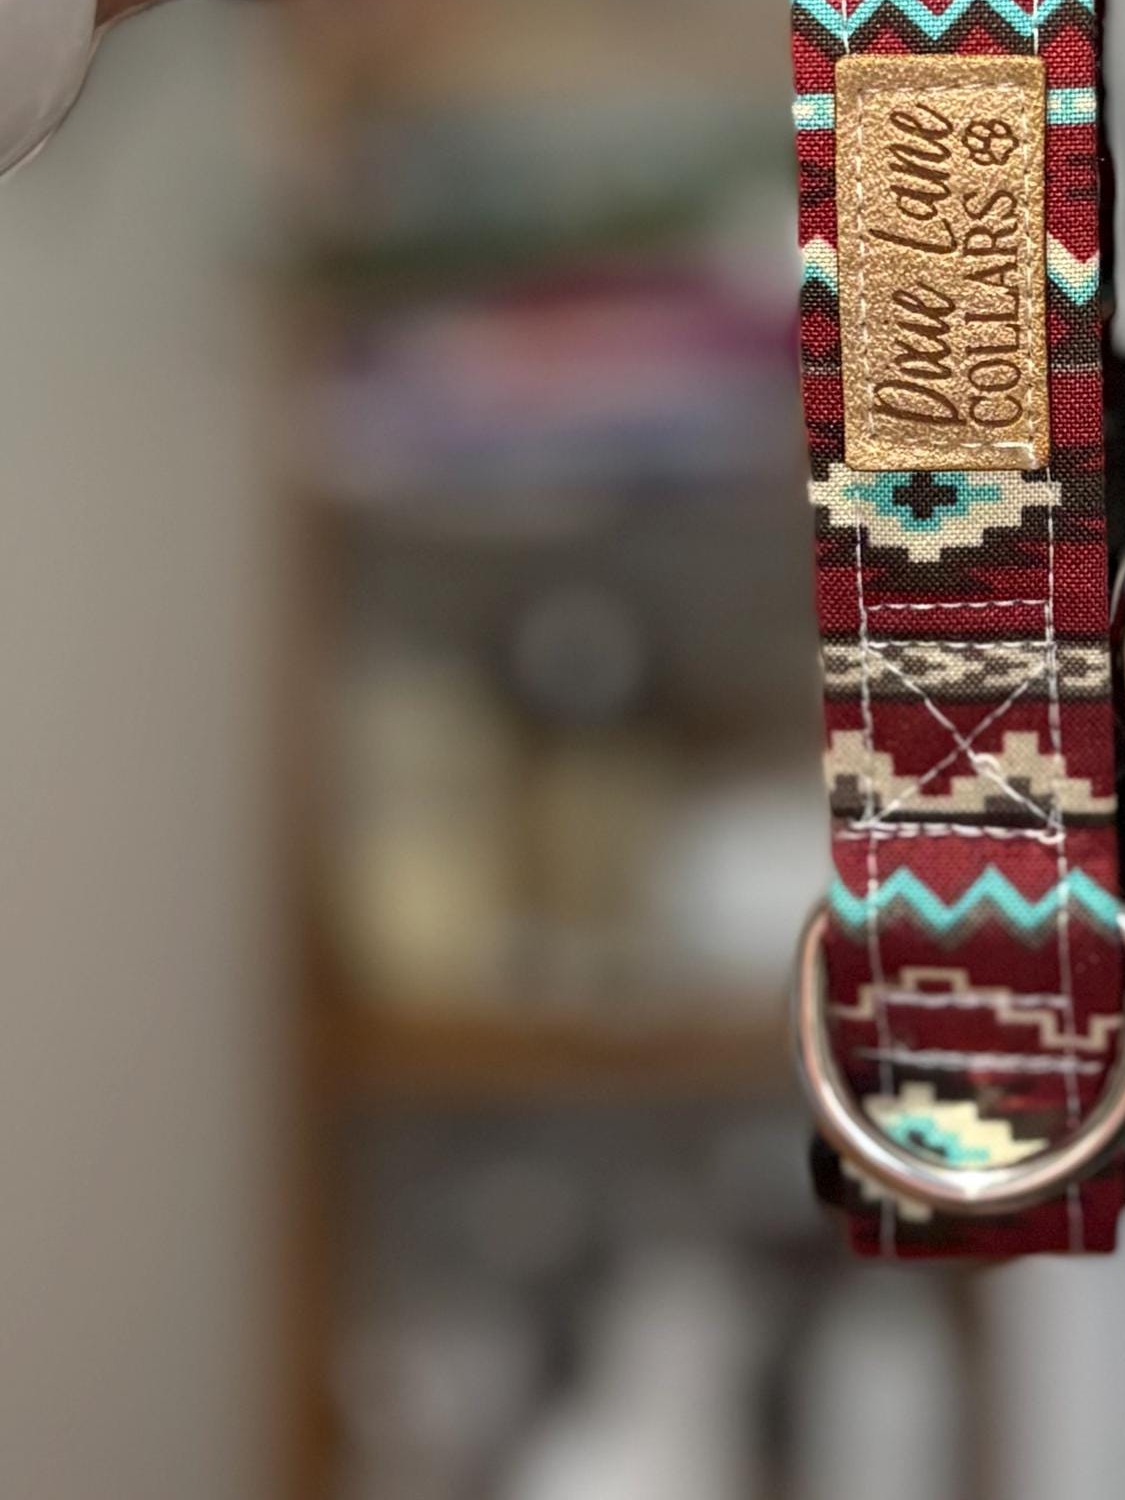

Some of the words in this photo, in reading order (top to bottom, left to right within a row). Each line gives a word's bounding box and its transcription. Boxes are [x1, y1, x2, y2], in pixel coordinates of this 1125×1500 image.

[868, 102, 958, 255] Lane
[872, 281, 967, 427] Dixie
[962, 191, 1024, 429] COLLARS
